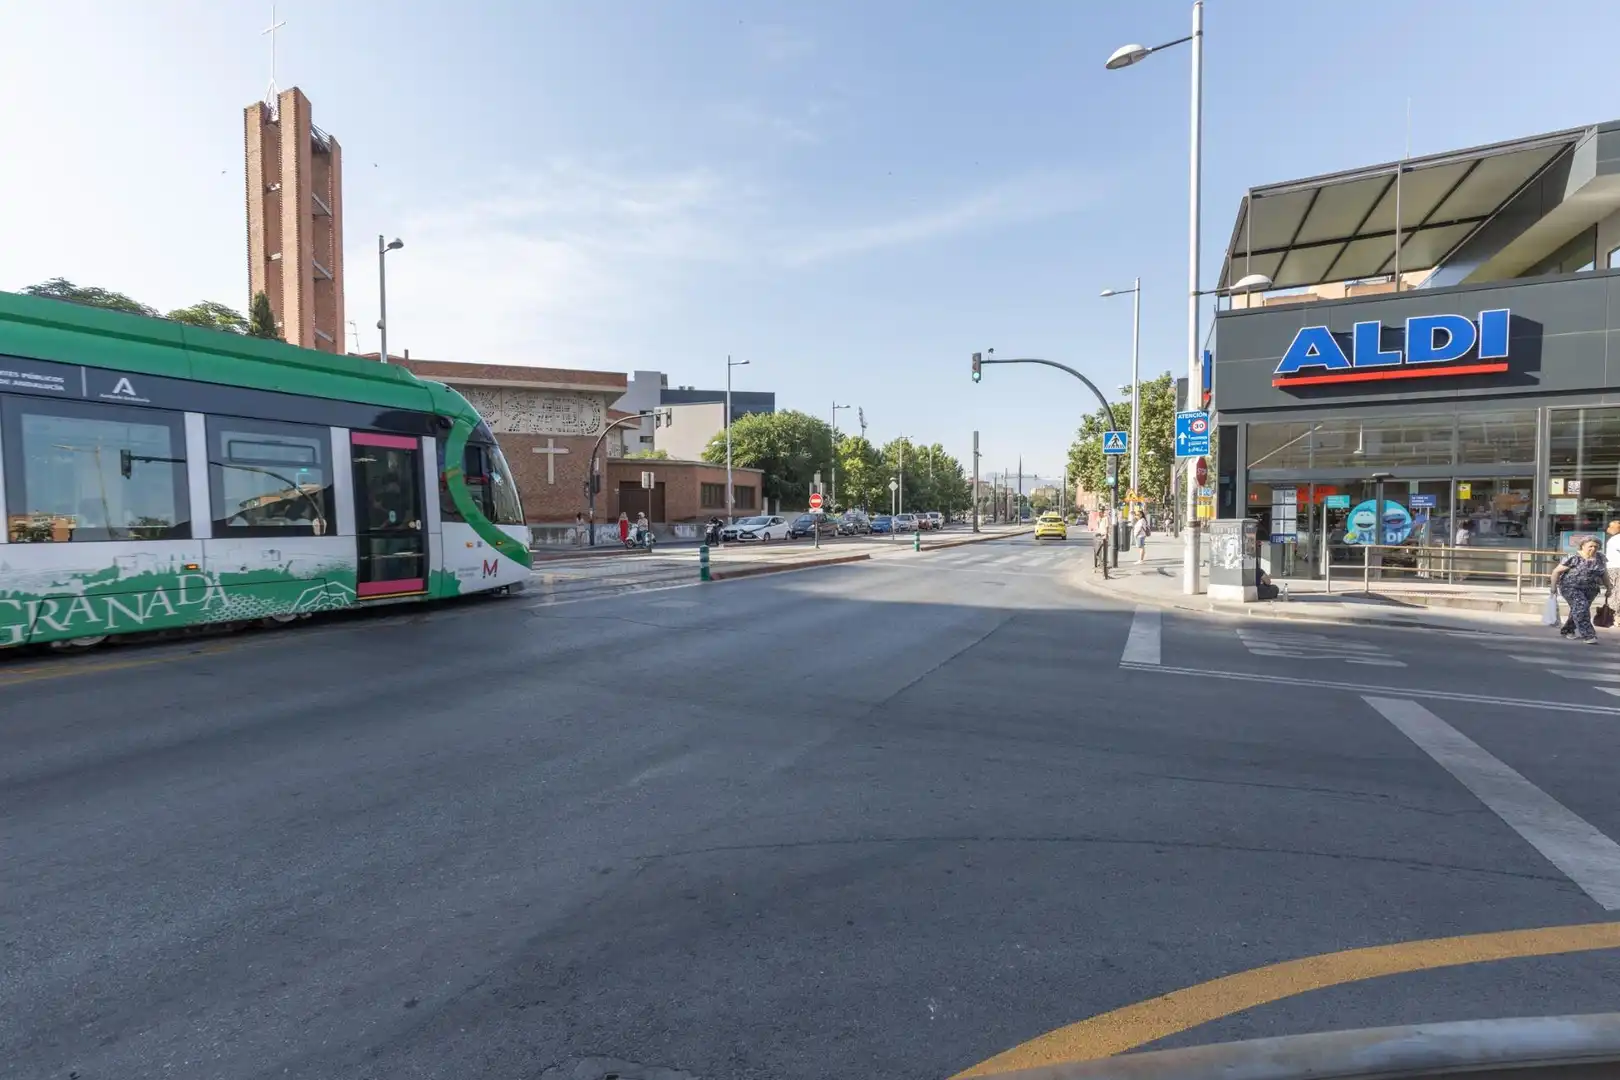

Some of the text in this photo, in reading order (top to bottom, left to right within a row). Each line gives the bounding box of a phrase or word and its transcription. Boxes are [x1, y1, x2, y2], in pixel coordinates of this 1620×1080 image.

[1273, 308, 1511, 374] ALDI
[1177, 411, 1208, 420] ATENCIÓN
[0, 573, 232, 647] GRANADA
